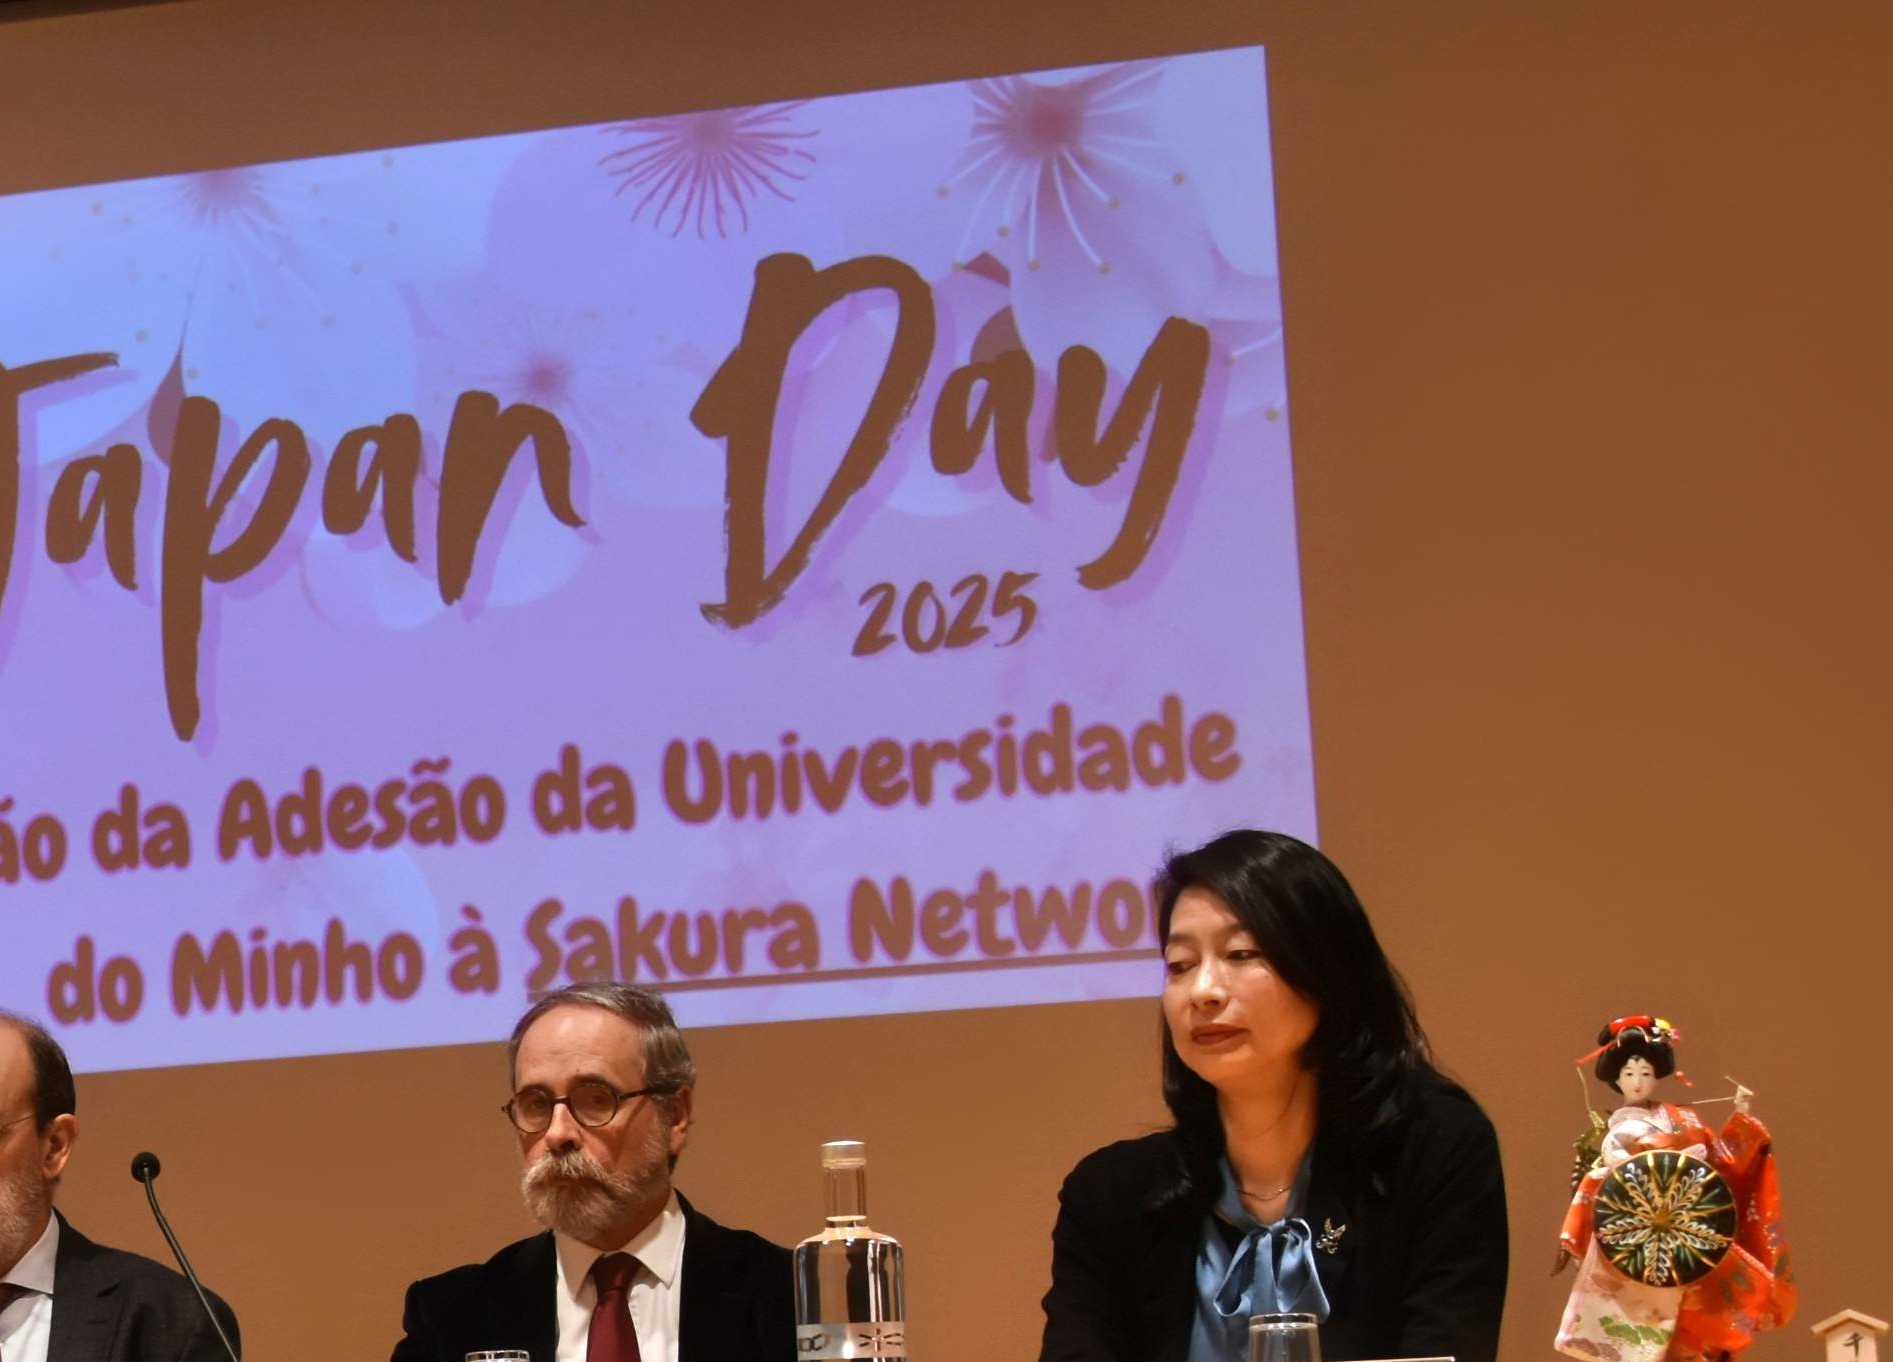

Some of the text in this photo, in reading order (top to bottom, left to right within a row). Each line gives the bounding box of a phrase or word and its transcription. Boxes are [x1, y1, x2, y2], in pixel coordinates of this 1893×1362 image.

[689, 252, 1209, 629] Day
[849, 571, 1038, 657] 2025
[91, 782, 192, 875] da
[217, 756, 505, 864] Adesão
[533, 743, 636, 835] da
[661, 694, 1243, 824] Universidade
[46, 869, 1163, 1025] do Minho à Sakura Netwo
